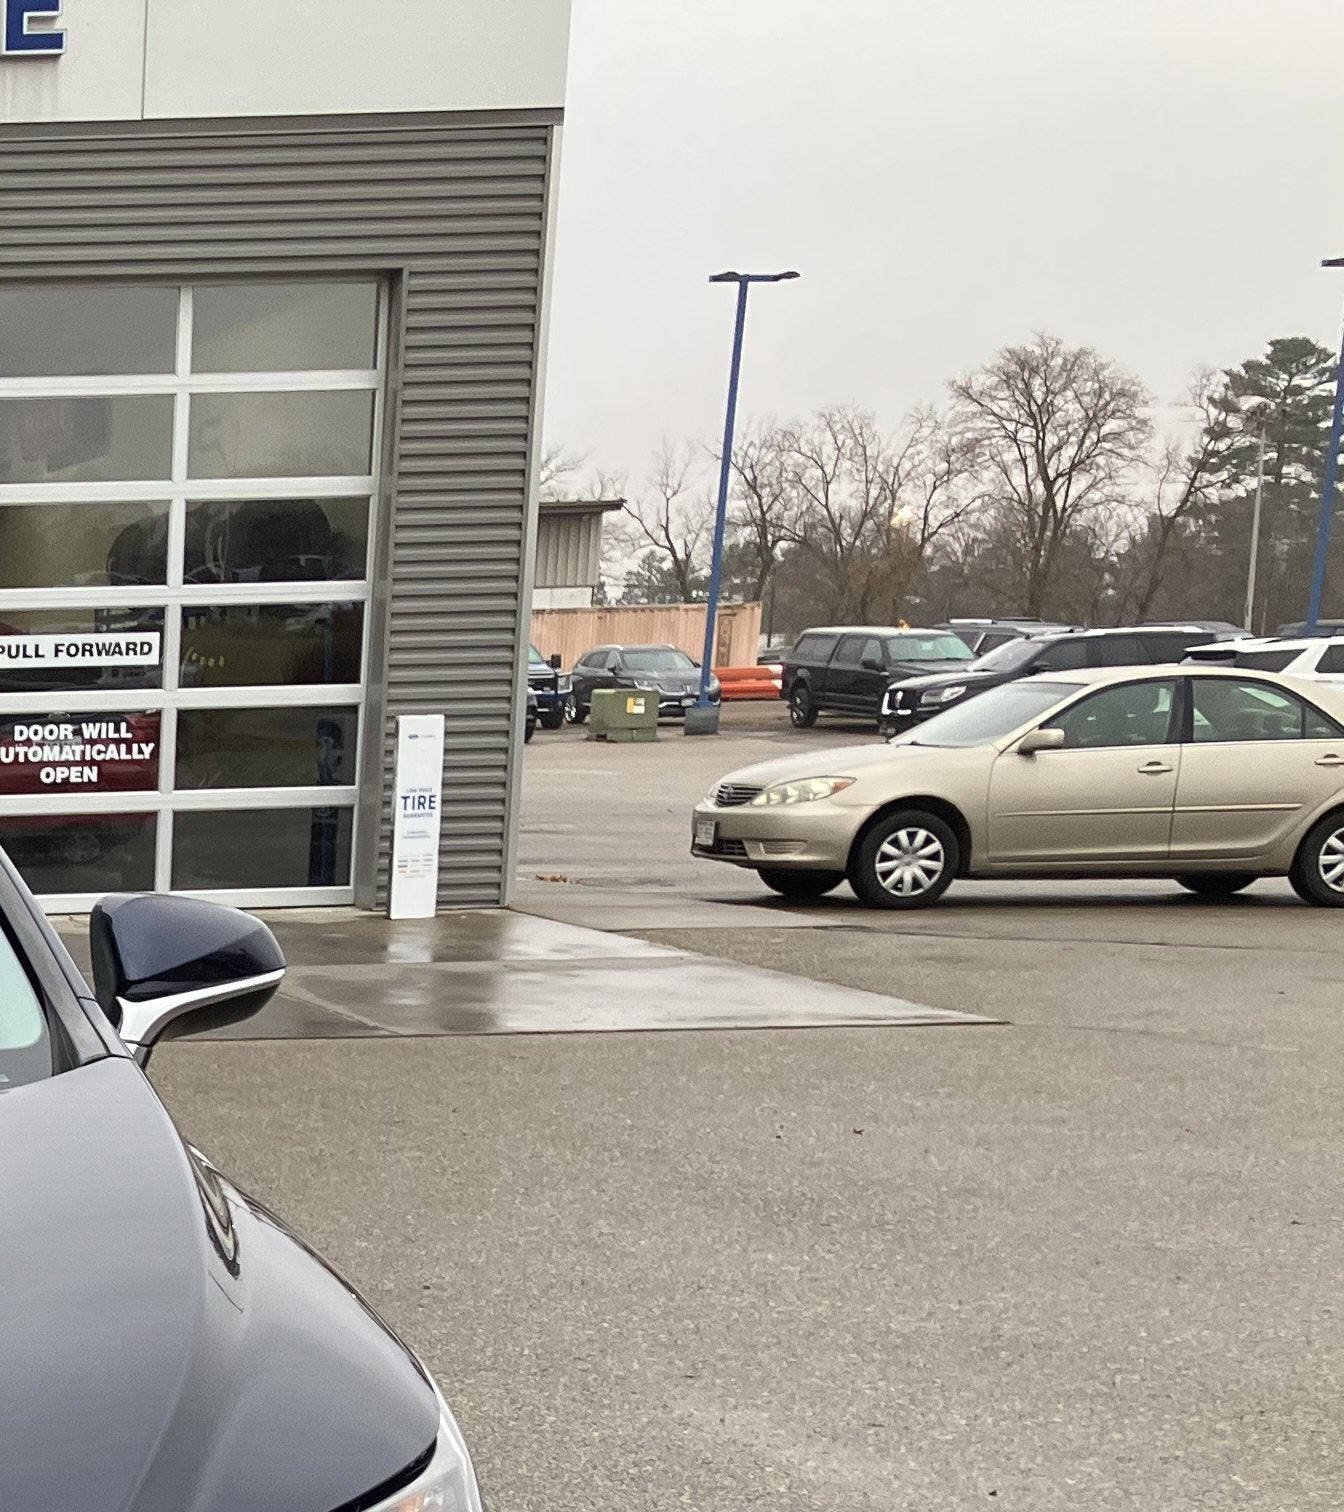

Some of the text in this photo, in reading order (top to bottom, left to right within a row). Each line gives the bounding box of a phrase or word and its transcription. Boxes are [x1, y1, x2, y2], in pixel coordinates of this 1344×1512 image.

[54, 641, 153, 658] FORWARD
[14, 721, 133, 742] DOOR WILL
[39, 765, 98, 784] OPEN
[400, 795, 437, 811] TIRE
